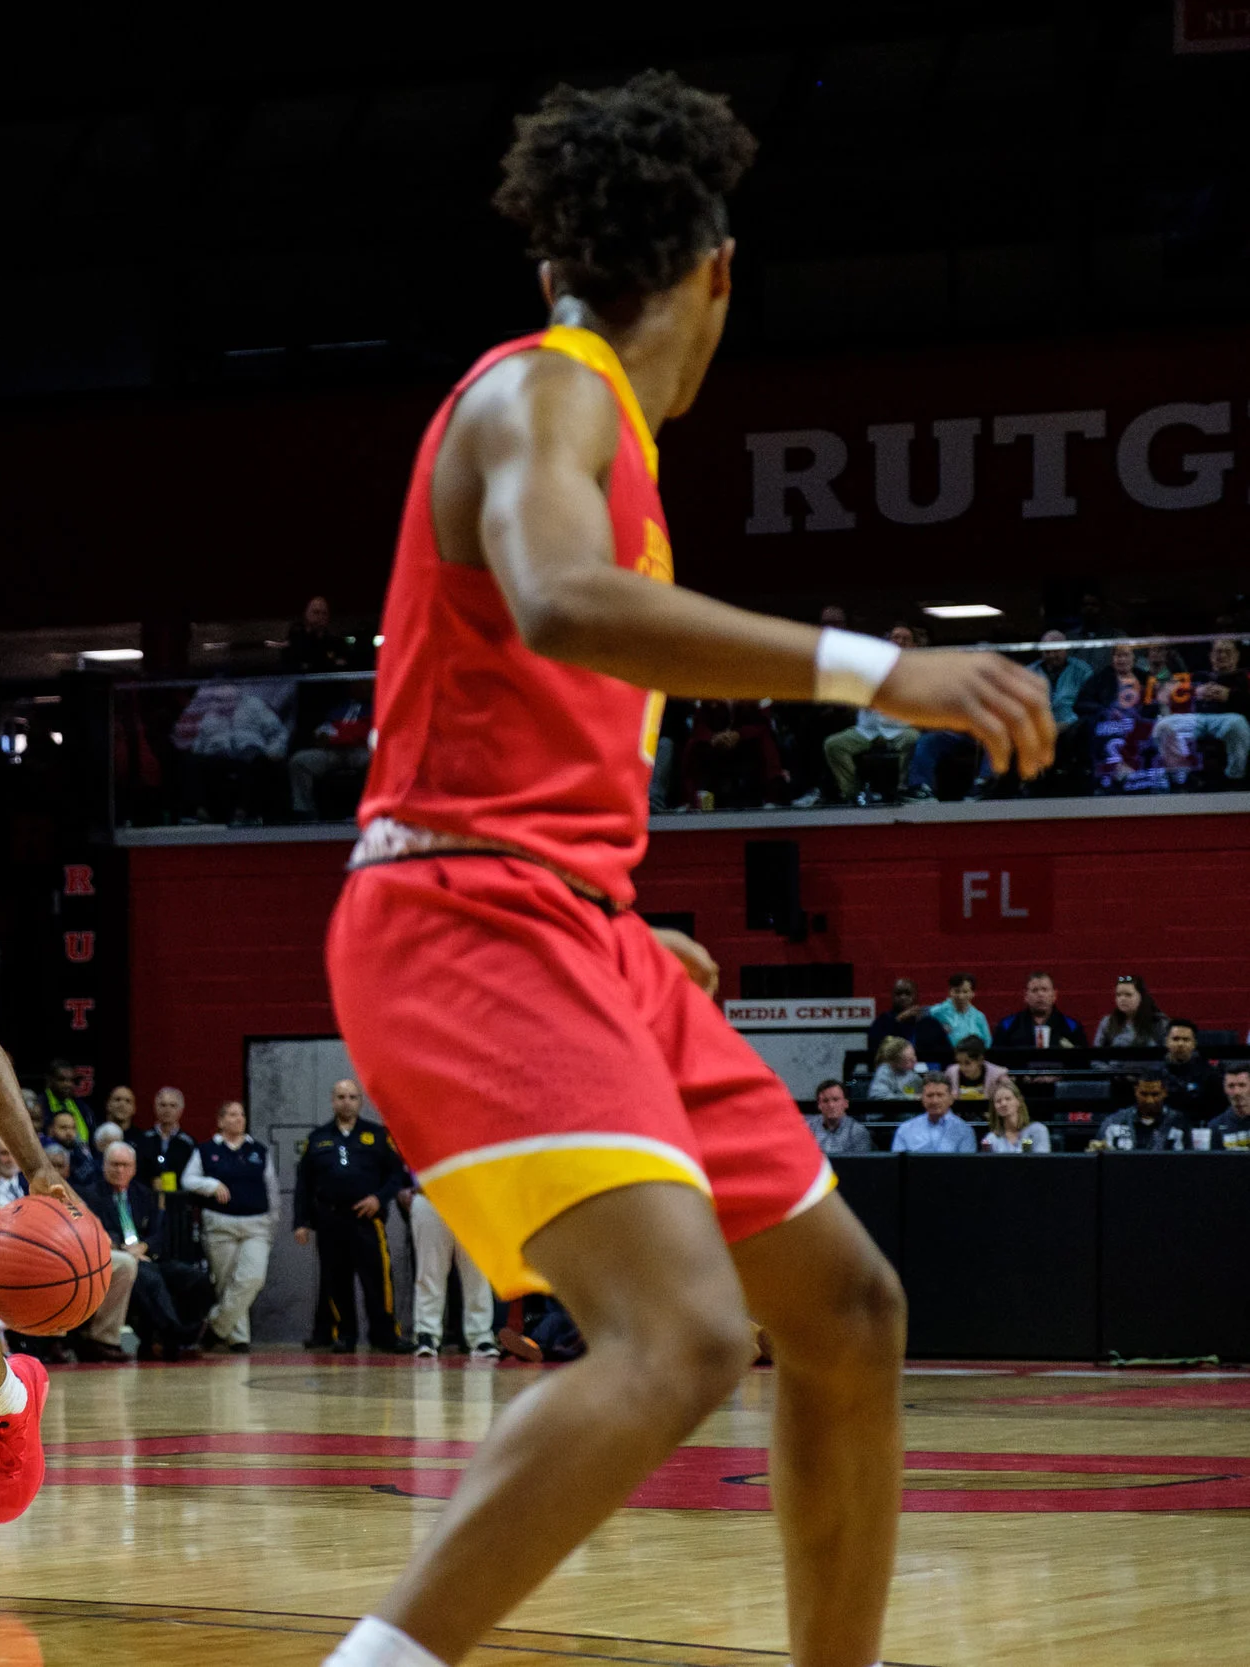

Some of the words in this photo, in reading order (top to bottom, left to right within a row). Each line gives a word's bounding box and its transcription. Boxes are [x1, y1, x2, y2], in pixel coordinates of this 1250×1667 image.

[744, 400, 1250, 537] RUTG
[962, 870, 1030, 919] FL
[728, 1006, 788, 1021] MEDIA
[795, 1005, 872, 1020] CENTER
